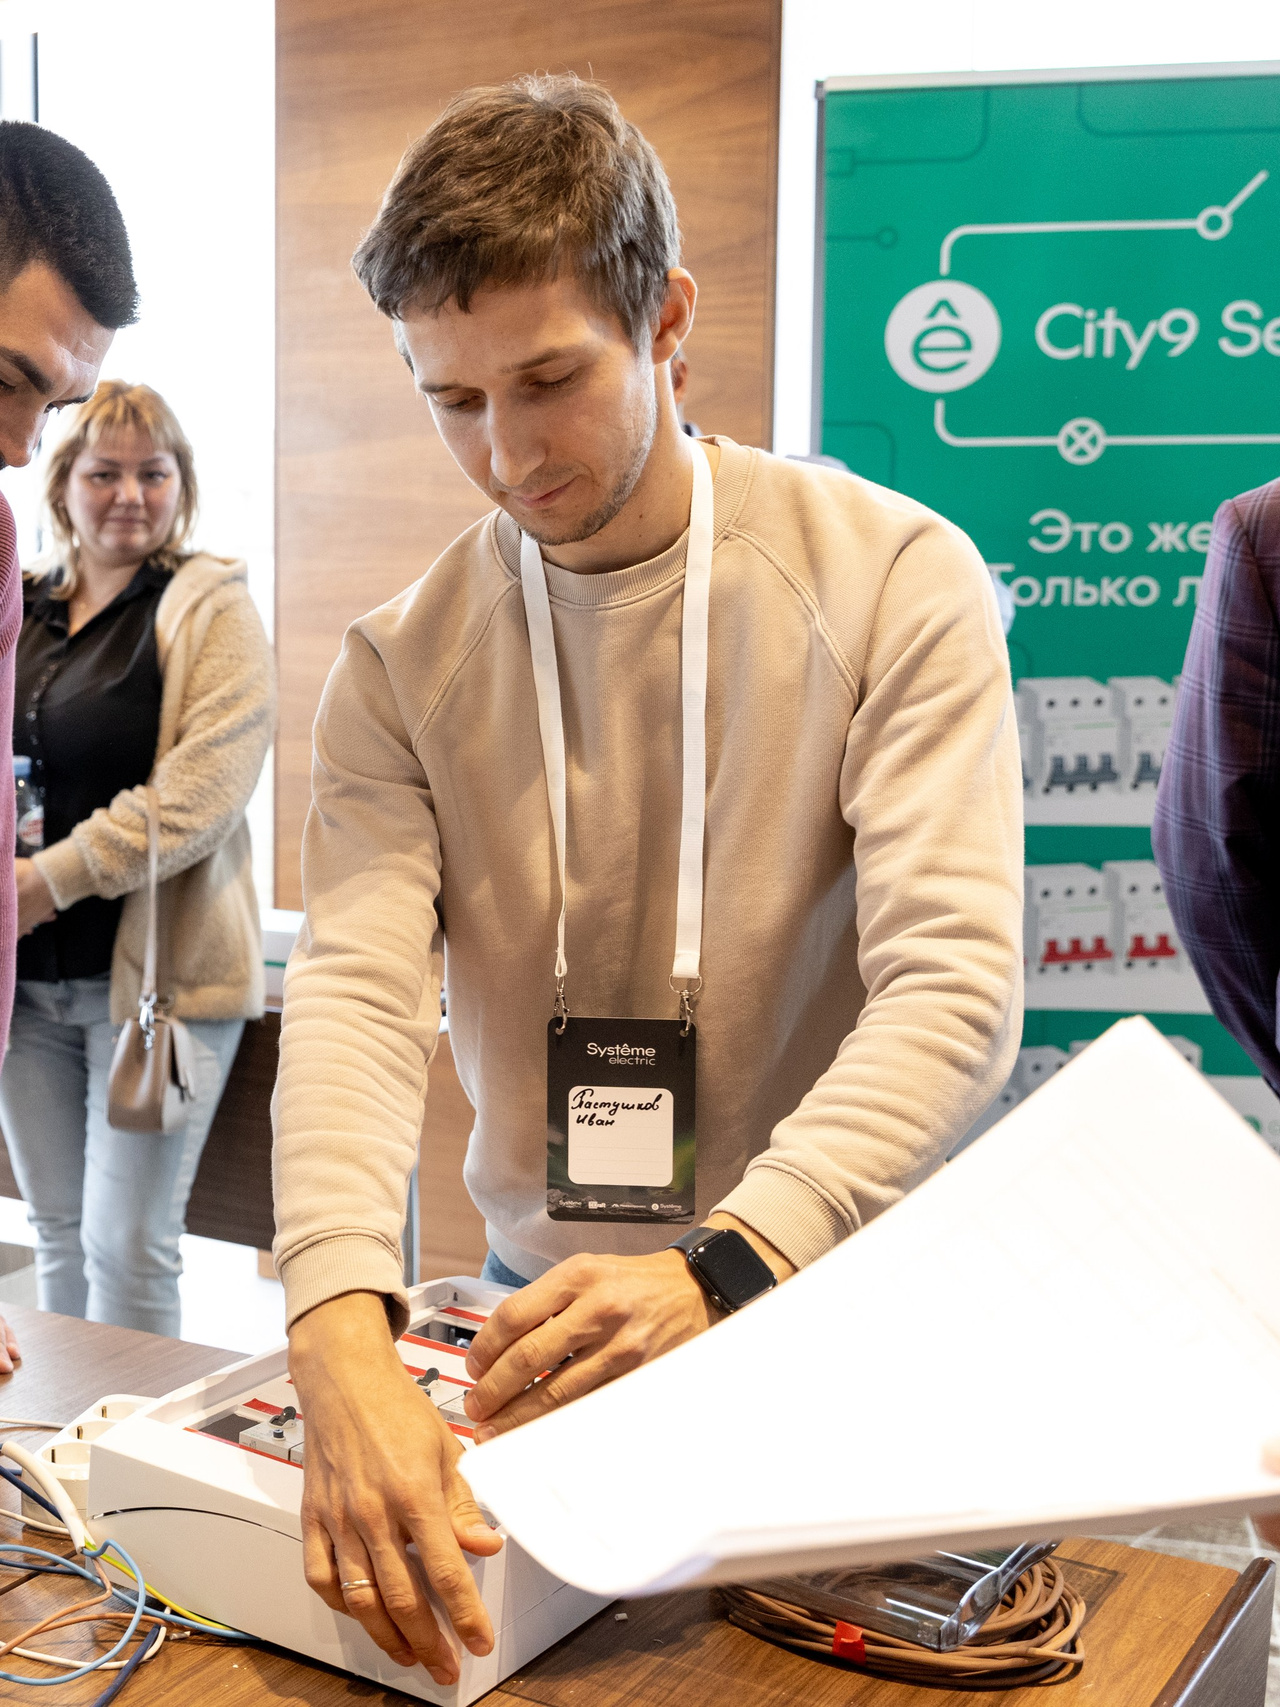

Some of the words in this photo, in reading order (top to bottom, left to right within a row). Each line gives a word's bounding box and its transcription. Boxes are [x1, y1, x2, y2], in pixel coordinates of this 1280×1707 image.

[1035, 301, 1200, 371] City9
[1028, 508, 1134, 553] Это
[586, 1042, 656, 1058] Systême
[608, 1056, 656, 1066] electric
[576, 1112, 615, 1126] Иван
